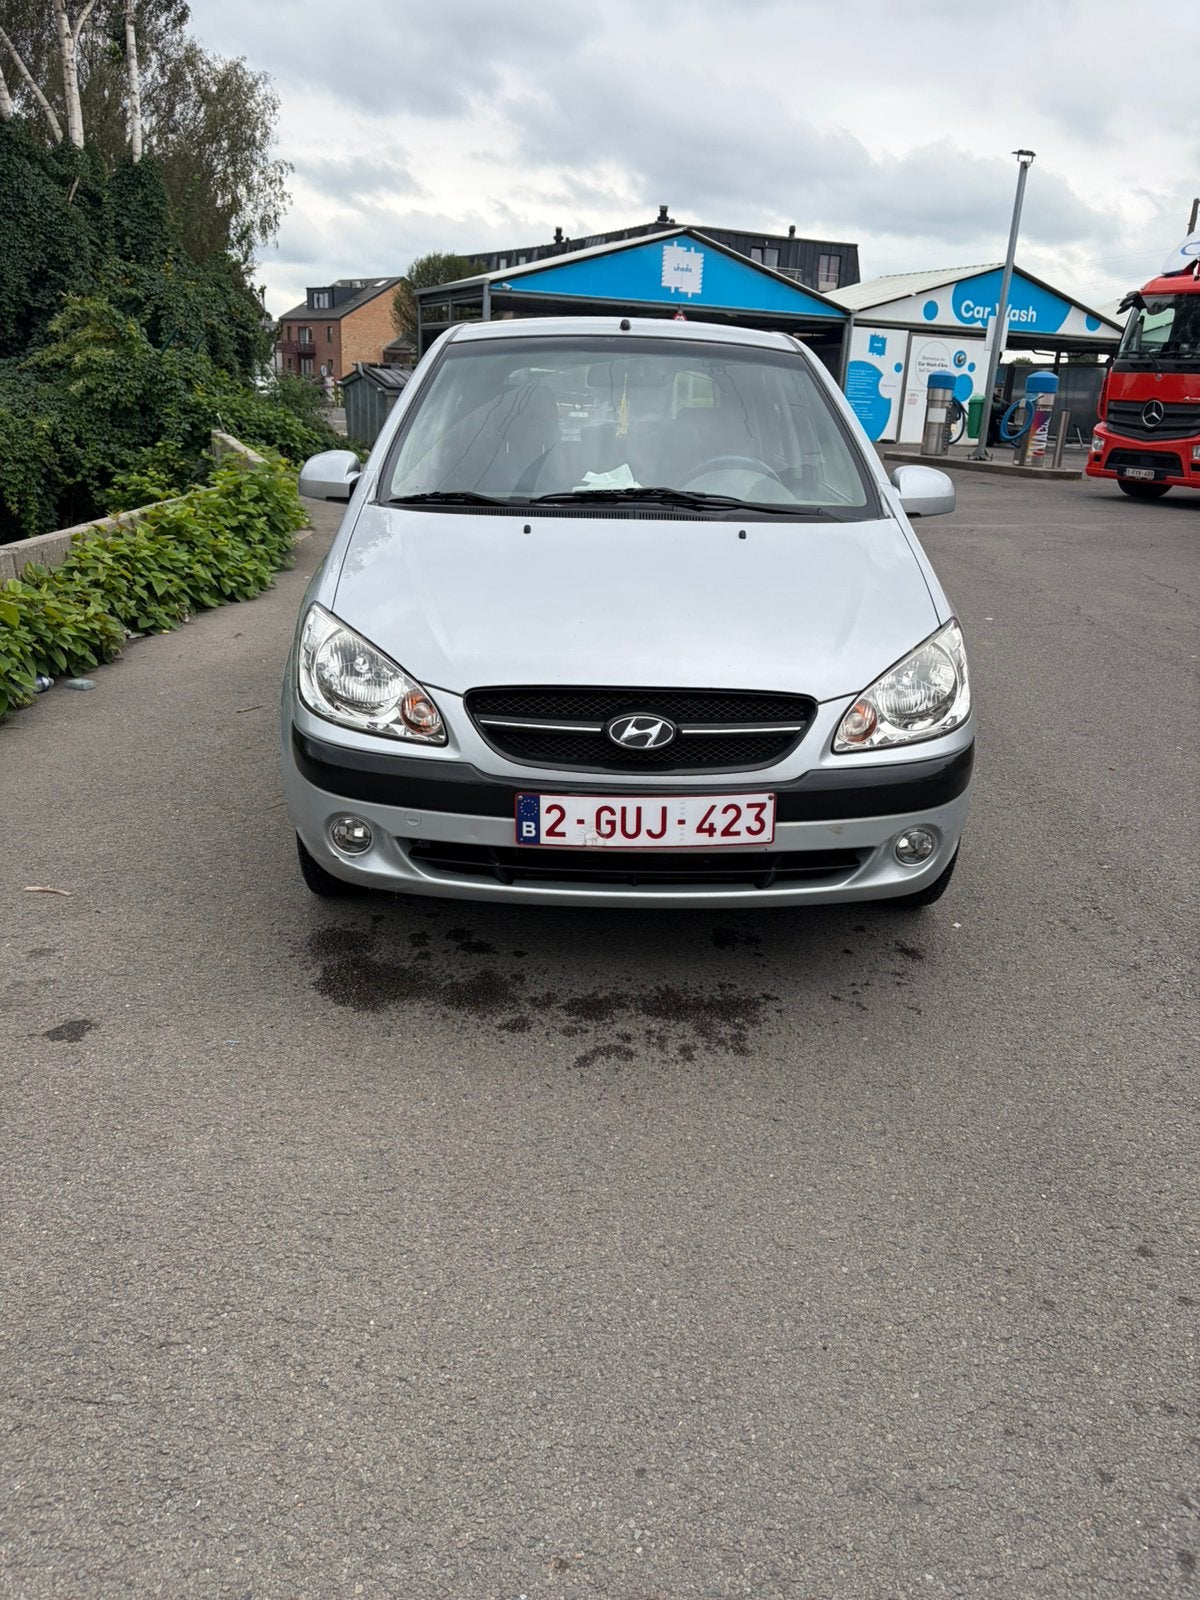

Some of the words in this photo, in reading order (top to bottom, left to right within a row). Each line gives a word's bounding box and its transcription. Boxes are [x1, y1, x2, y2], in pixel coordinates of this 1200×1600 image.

[961, 300, 991, 319] Car
[522, 821, 536, 837] B
[545, 803, 767, 839] 2-GUJ-423
